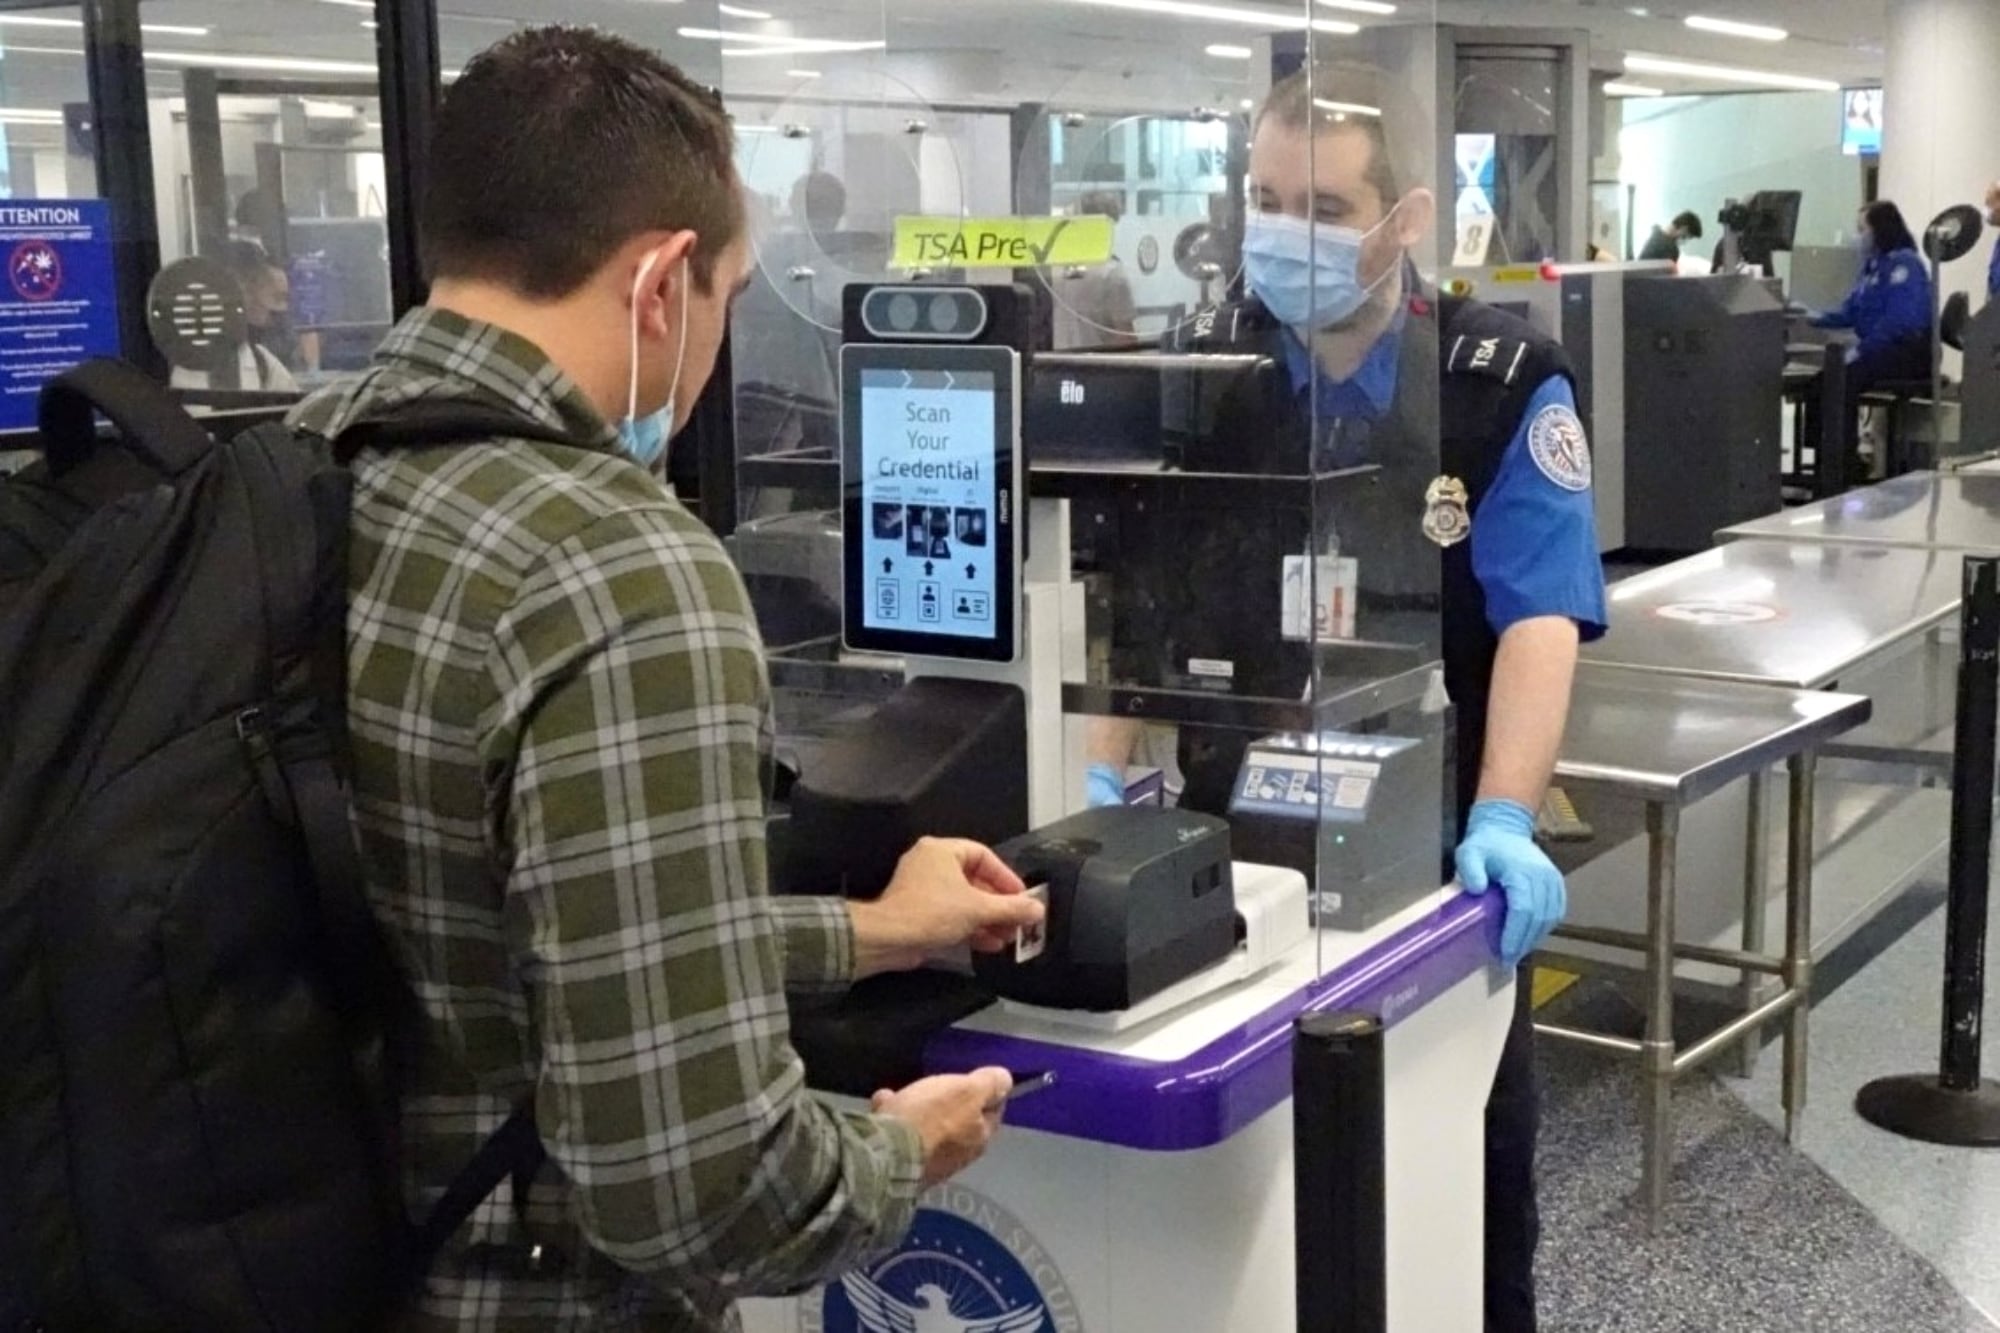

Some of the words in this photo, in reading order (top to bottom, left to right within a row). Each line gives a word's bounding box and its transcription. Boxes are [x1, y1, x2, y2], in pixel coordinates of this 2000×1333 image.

[914, 233, 968, 260] TSA
[976, 232, 1028, 260] Pre
[1193, 310, 1216, 338] TSA
[1469, 337, 1500, 368] TSA
[906, 402, 951, 423] Scan
[906, 430, 951, 451] Your
[878, 457, 980, 481] Credential
